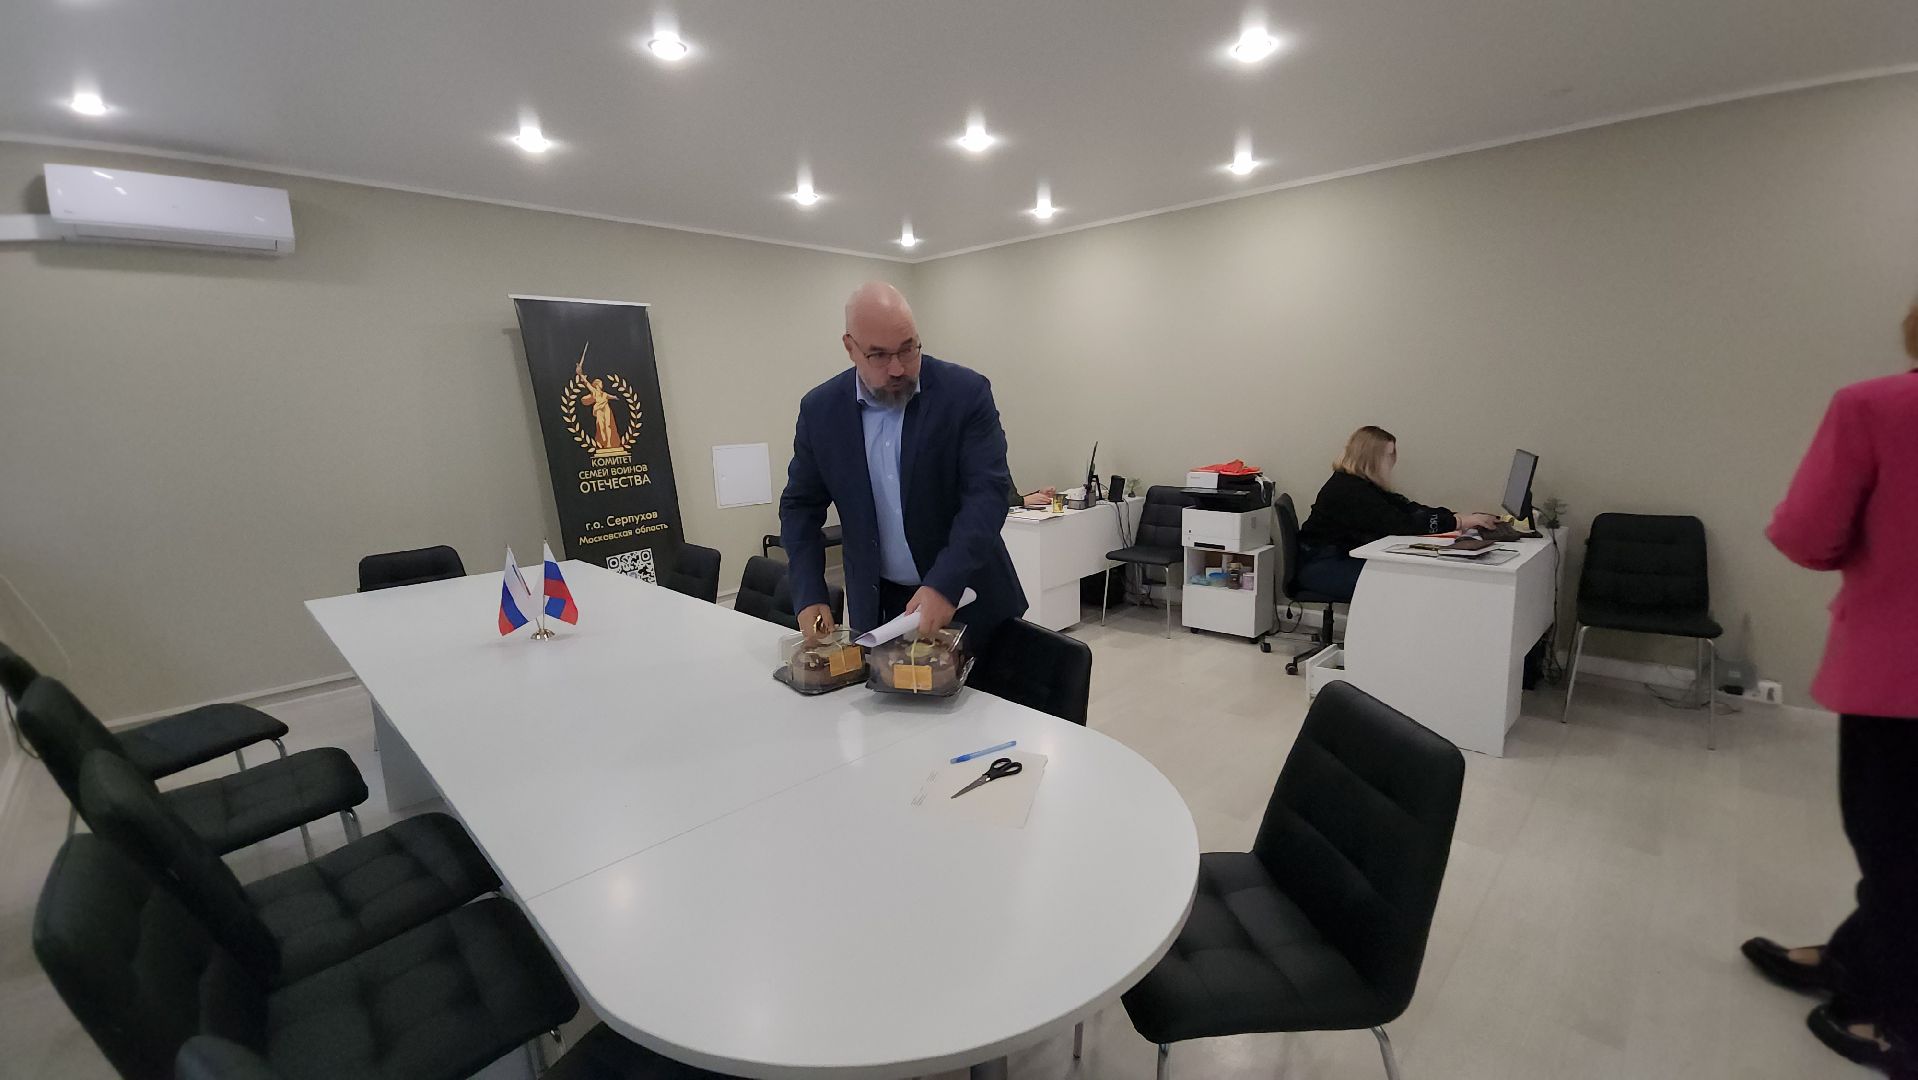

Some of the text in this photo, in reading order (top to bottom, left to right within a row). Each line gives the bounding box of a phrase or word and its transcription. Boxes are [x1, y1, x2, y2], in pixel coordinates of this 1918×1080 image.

[591, 456, 632, 467] КОМИТЕТ
[579, 464, 648, 480] СЕМЕЙ ВОИНОВ
[580, 474, 651, 493] ОТЕЧЕСТВА
[586, 512, 658, 531] г.о. Серпухов
[579, 523, 668, 545] Московская область
